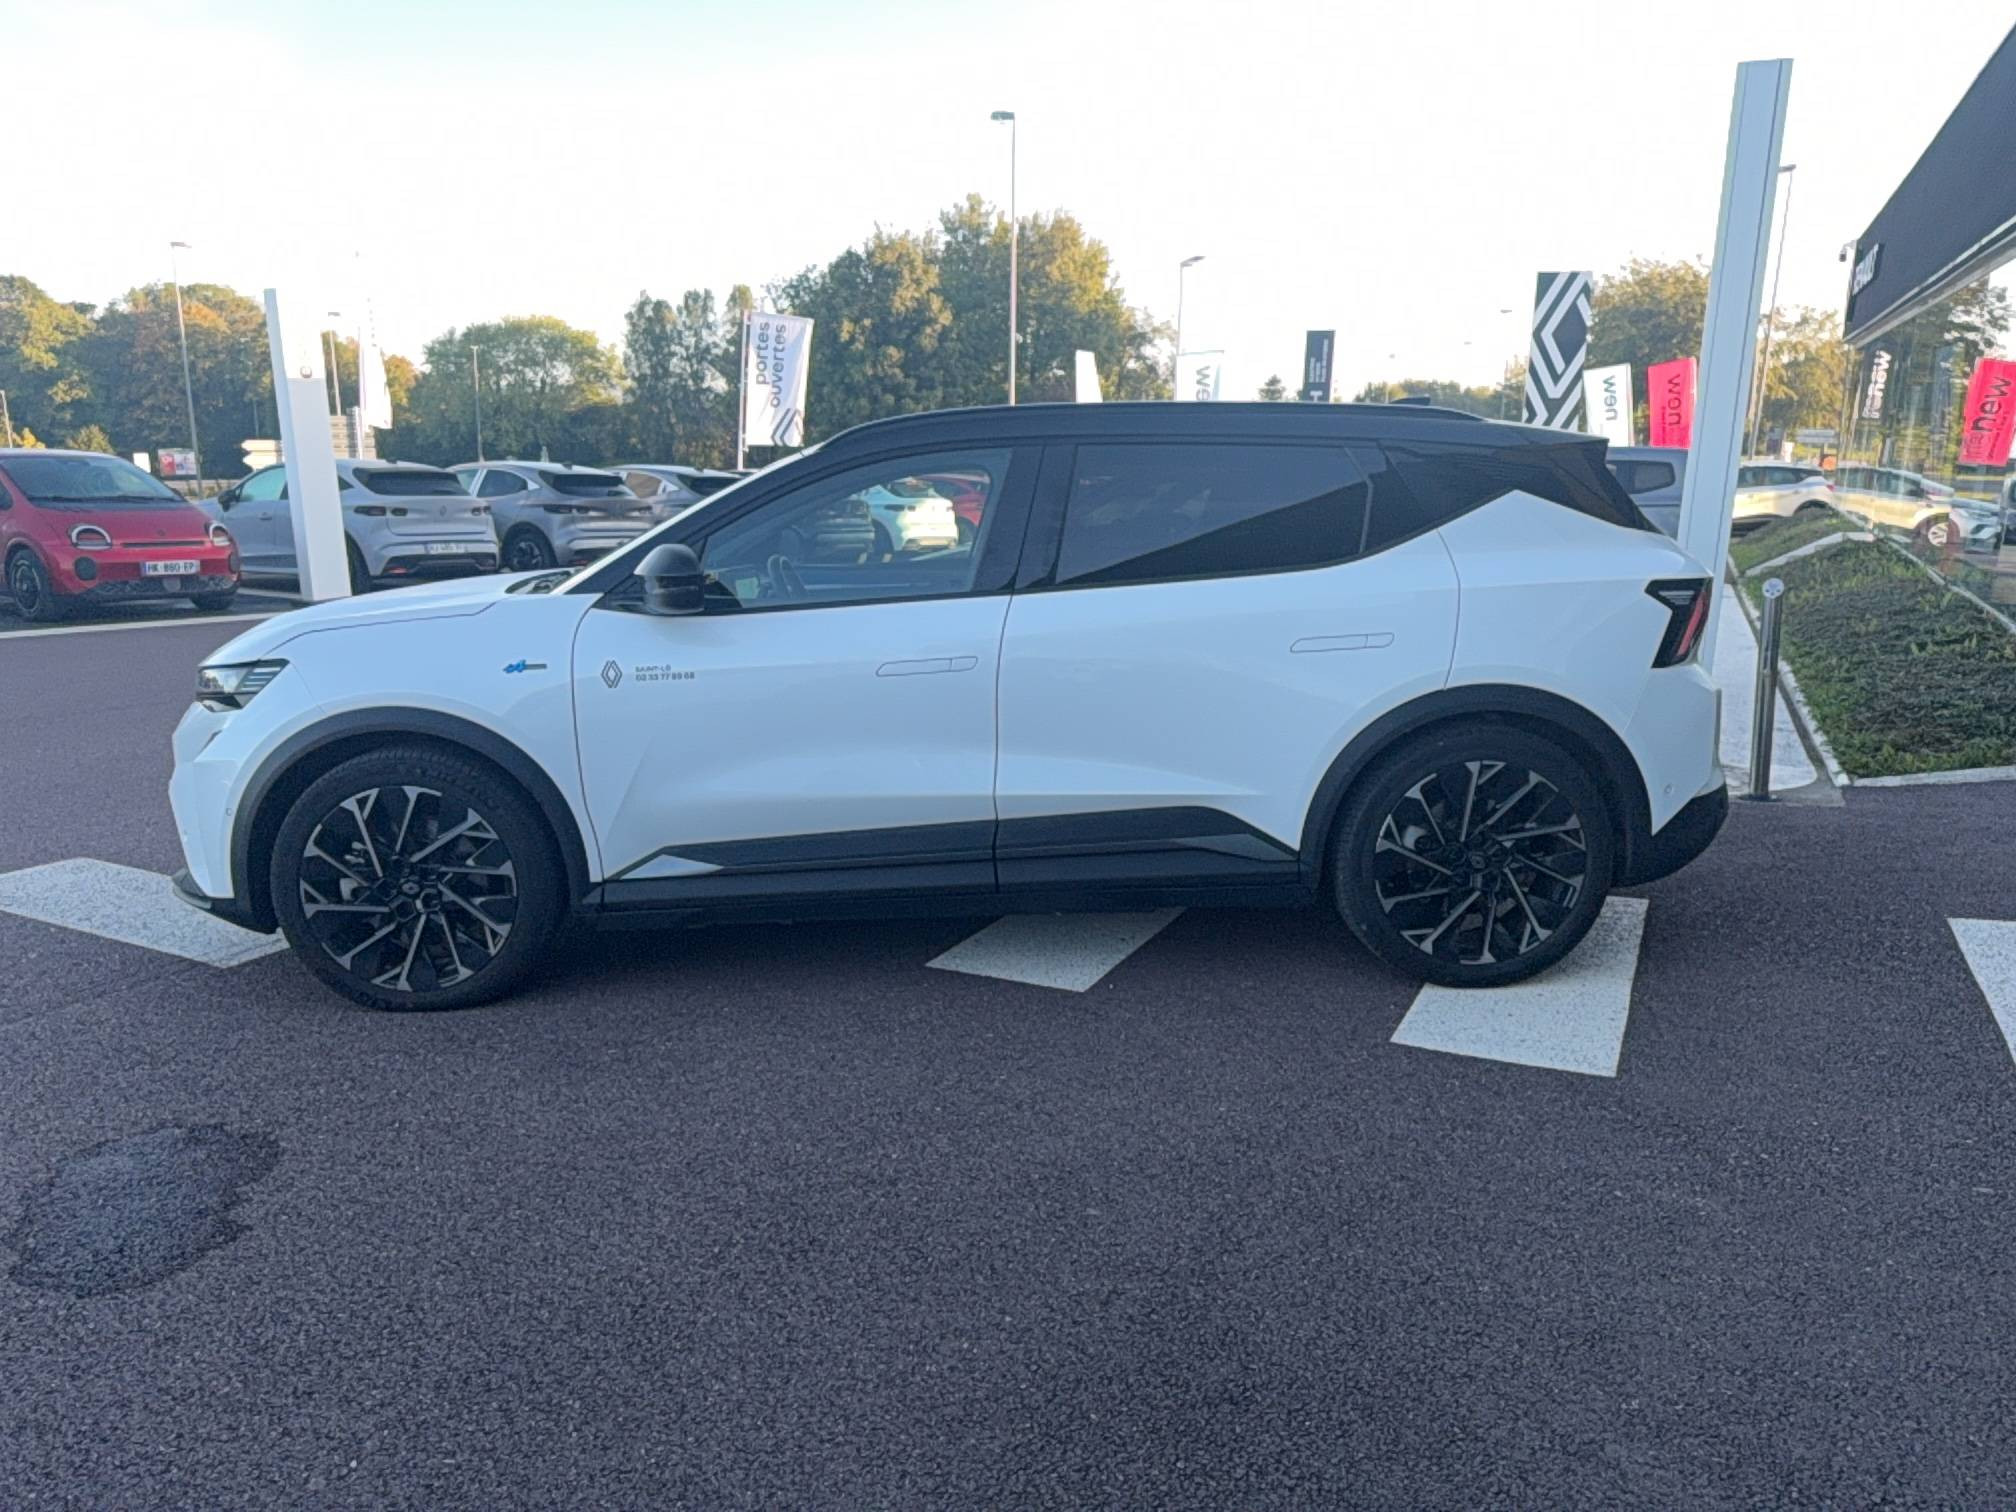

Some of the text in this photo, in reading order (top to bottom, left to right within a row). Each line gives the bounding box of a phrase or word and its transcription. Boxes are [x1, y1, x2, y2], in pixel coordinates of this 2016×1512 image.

[756, 322, 770, 385] portes
[770, 324, 786, 408] ouvertes
[1971, 376, 2012, 432] new
[660, 672, 671, 681] 77
